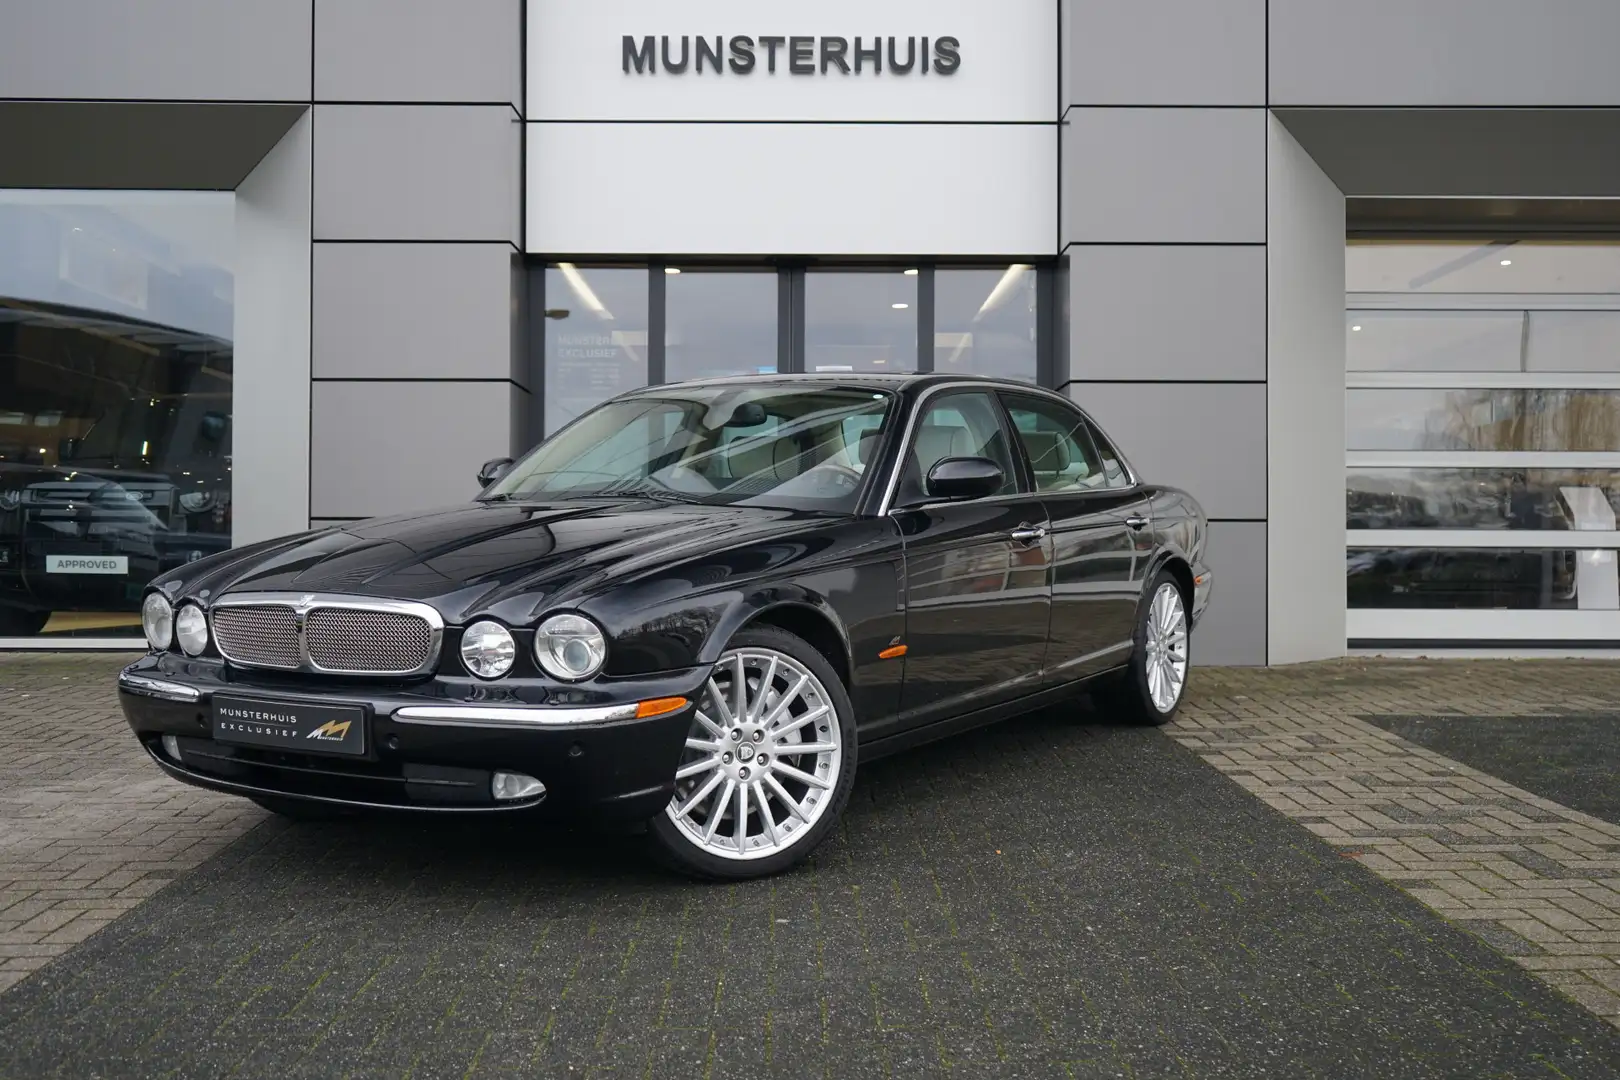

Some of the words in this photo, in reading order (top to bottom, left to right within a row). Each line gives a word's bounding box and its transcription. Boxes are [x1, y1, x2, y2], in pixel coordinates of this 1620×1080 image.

[622, 35, 962, 75] MUNSTERHUIS
[57, 559, 117, 569] APPROVED
[219, 707, 298, 723] MUNSTERHUIS
[220, 722, 298, 737] EXCLUSIEF
